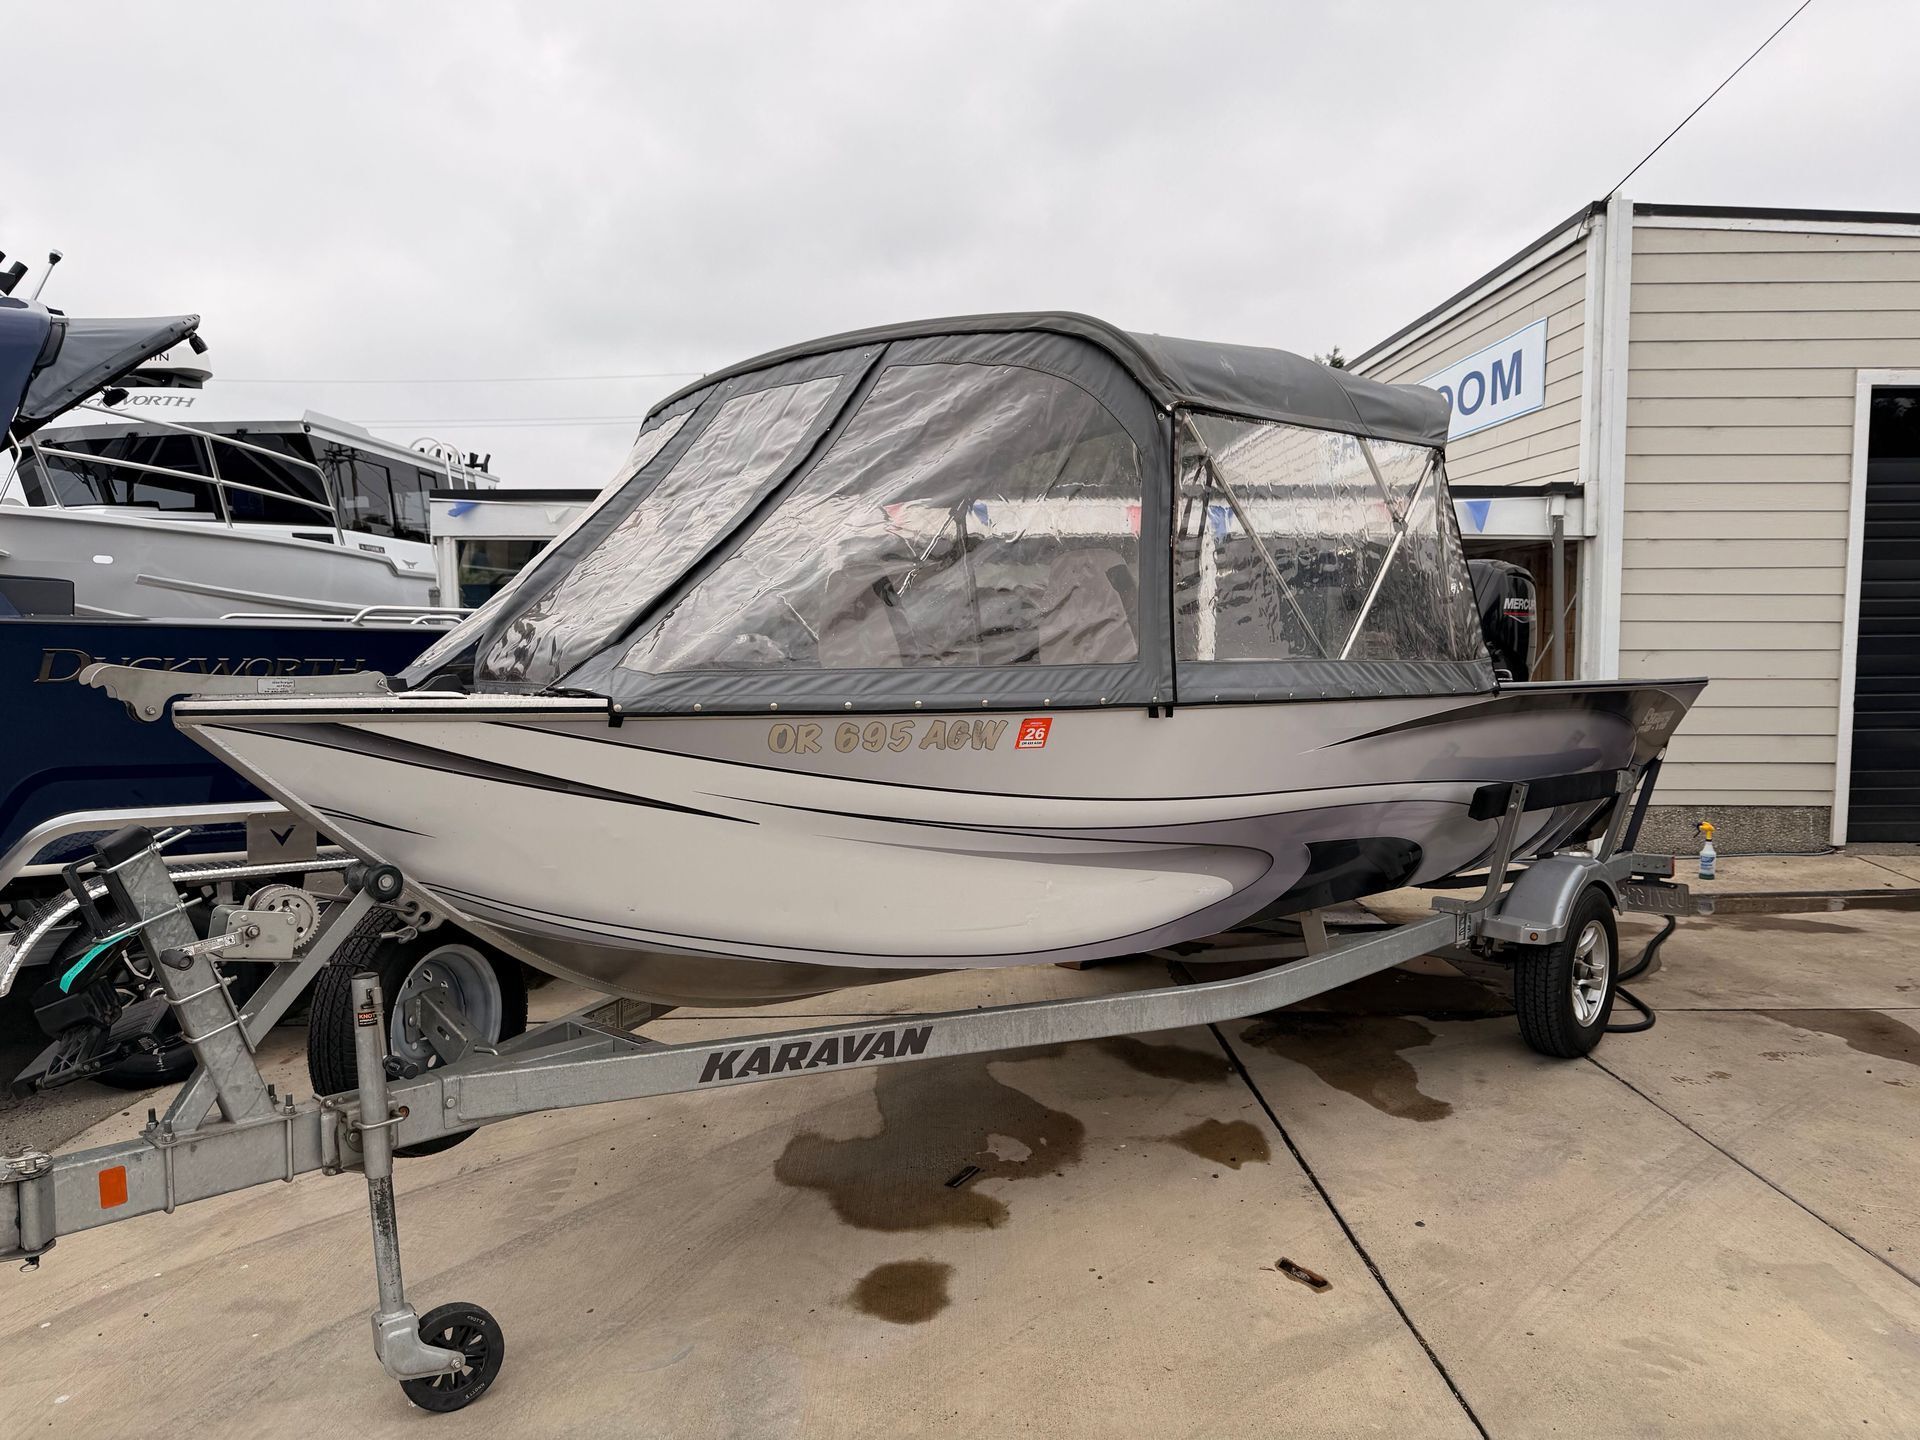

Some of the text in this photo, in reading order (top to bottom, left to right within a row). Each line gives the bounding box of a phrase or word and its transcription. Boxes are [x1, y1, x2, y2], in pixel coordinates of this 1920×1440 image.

[768, 719, 1008, 754] OR 695 AGW
[1024, 727, 1045, 740] 26
[698, 1025, 933, 1083] KARAVAN
